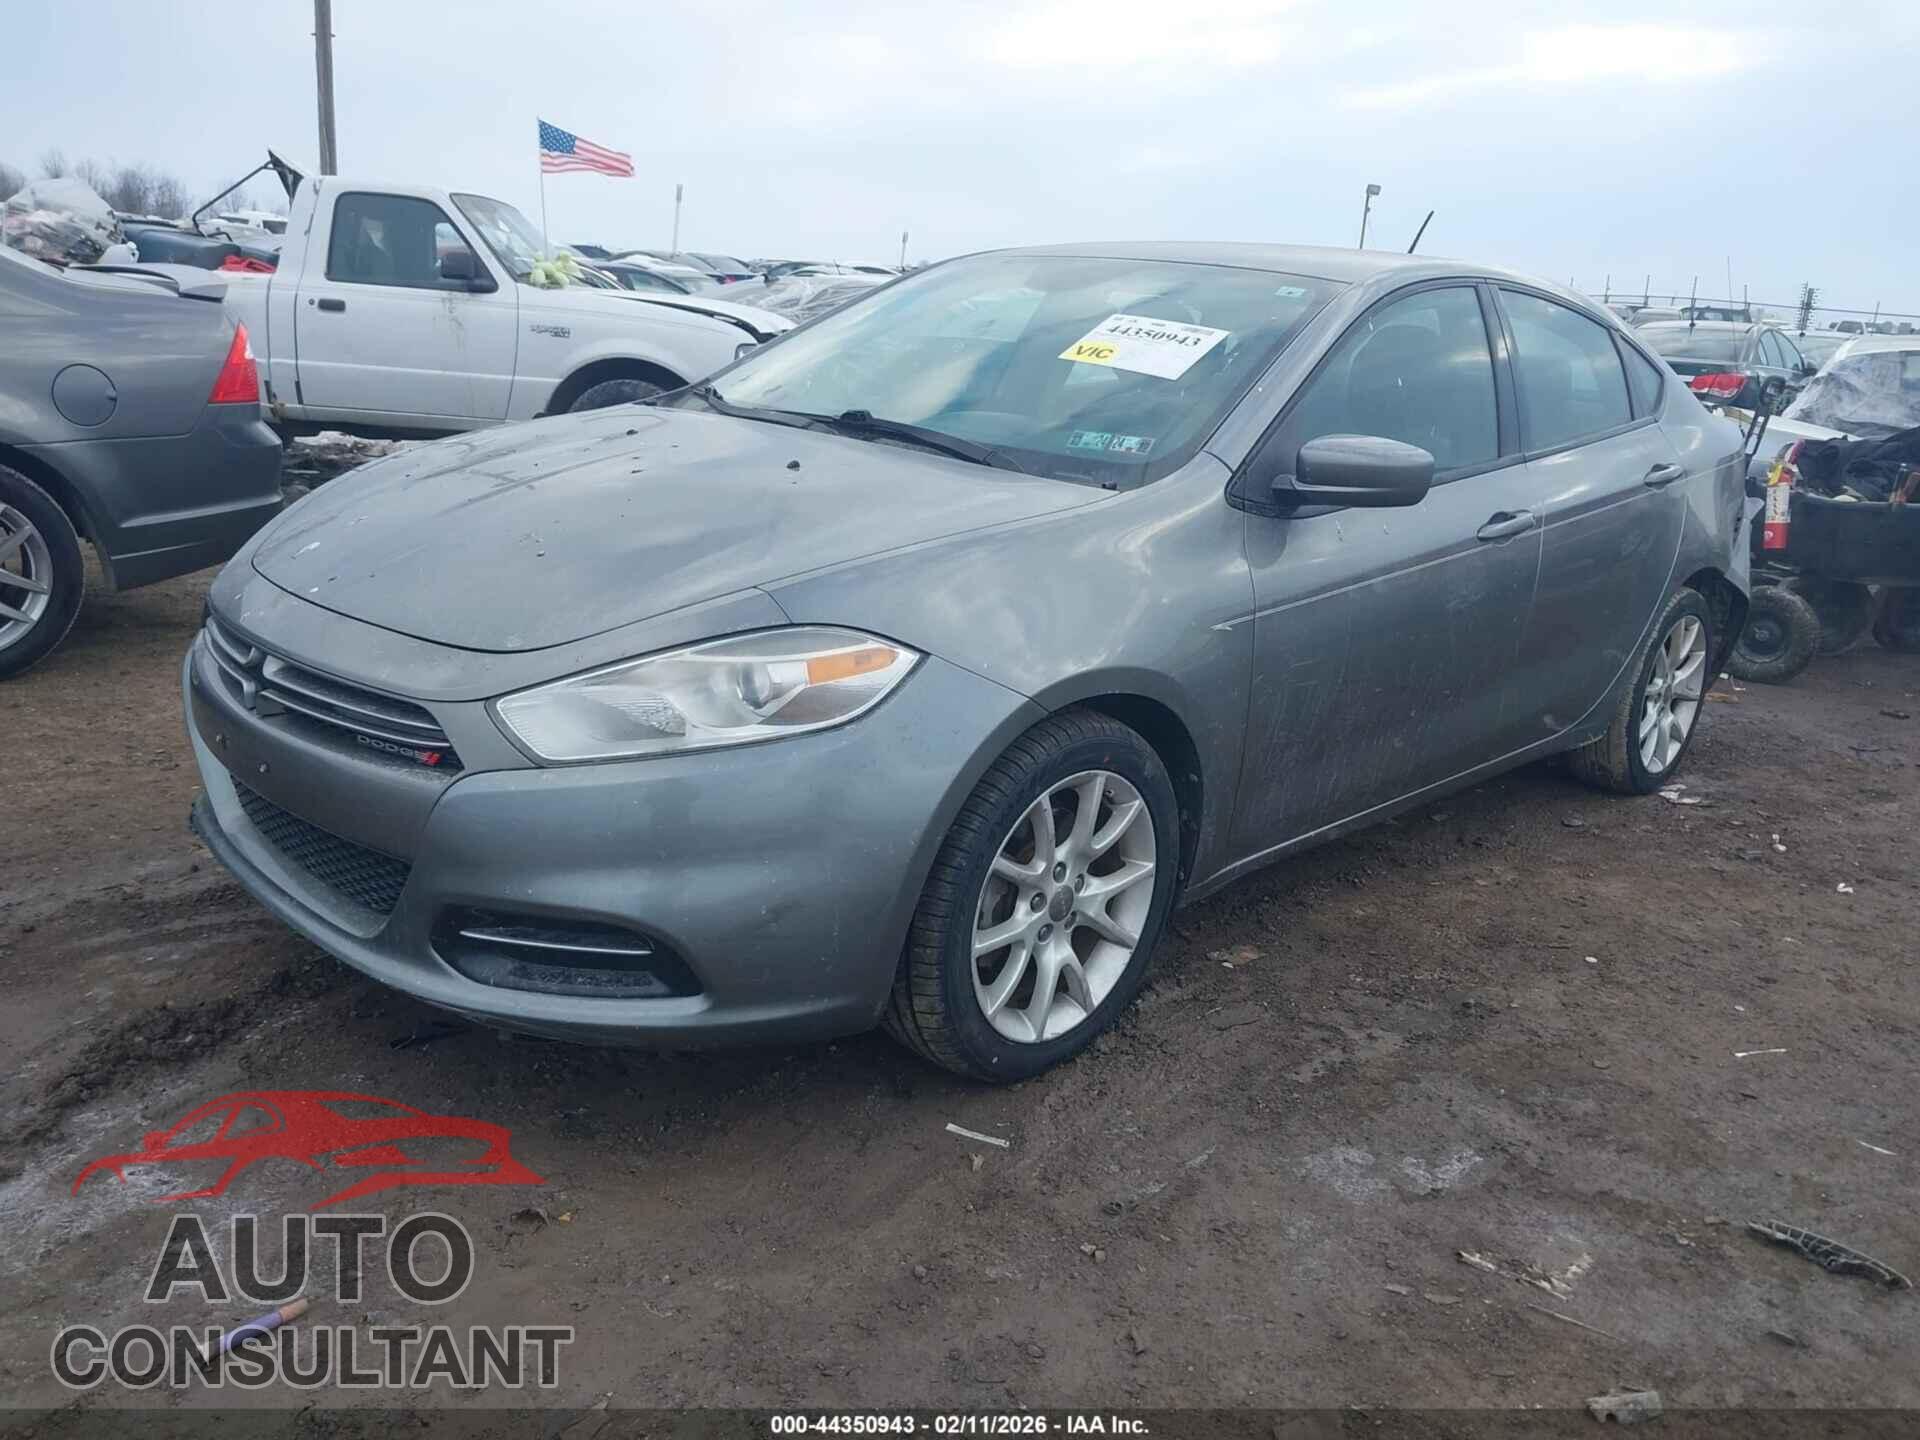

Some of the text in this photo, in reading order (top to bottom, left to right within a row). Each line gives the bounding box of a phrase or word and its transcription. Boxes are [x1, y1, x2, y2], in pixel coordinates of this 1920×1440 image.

[1106, 324, 1202, 348] 44350943
[1075, 345, 1114, 359] VIC
[357, 735, 425, 760] DODGE
